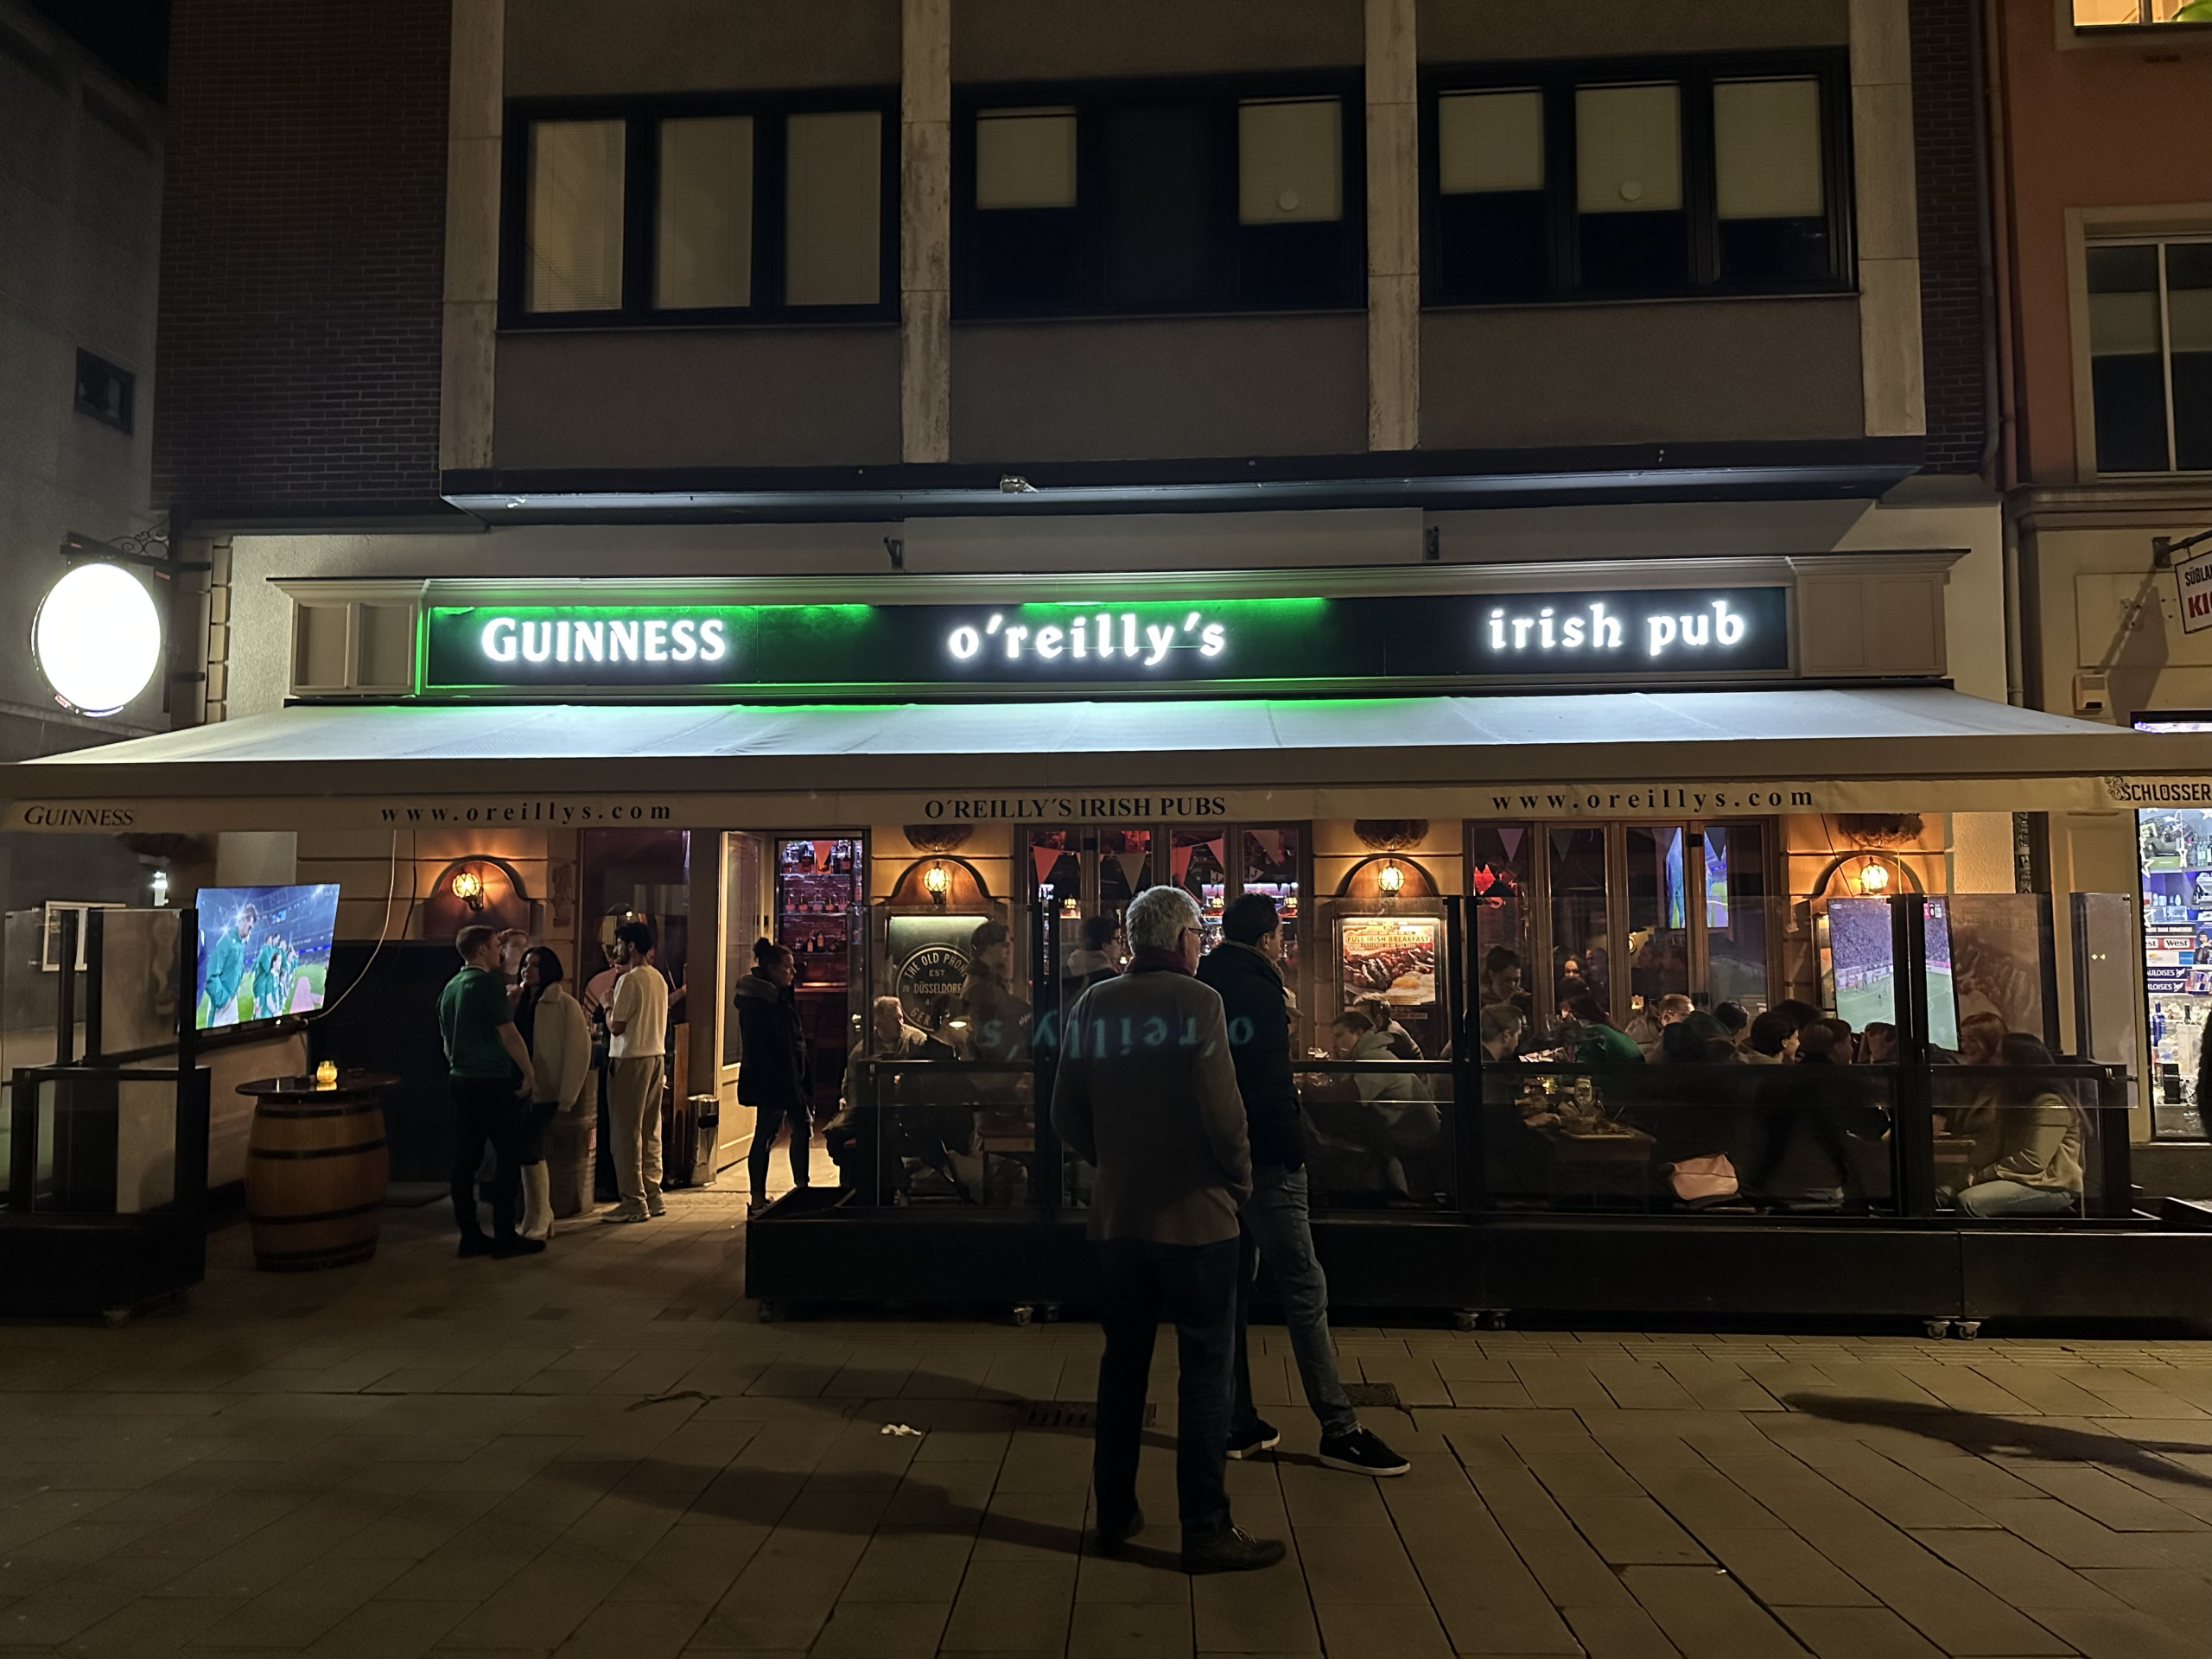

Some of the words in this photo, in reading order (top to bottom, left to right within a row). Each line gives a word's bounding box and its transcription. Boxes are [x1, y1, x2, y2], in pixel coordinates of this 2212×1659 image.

[2188, 591, 2212, 619] KI
[480, 617, 726, 663] GUINNESS
[949, 612, 1225, 666] o'reilly's
[1489, 602, 1624, 650] irish
[1647, 601, 1745, 657] pub
[381, 802, 671, 825] www.oreillys.com
[1080, 797, 1151, 817] IRISH
[1160, 796, 1227, 817] PUBS
[1491, 789, 1814, 813] www.oreillys.com
[24, 805, 134, 826] GUINNESS
[904, 961, 920, 979] THE
[921, 952, 939, 966] OLD
[913, 981, 962, 995] DÜSSELDORF
